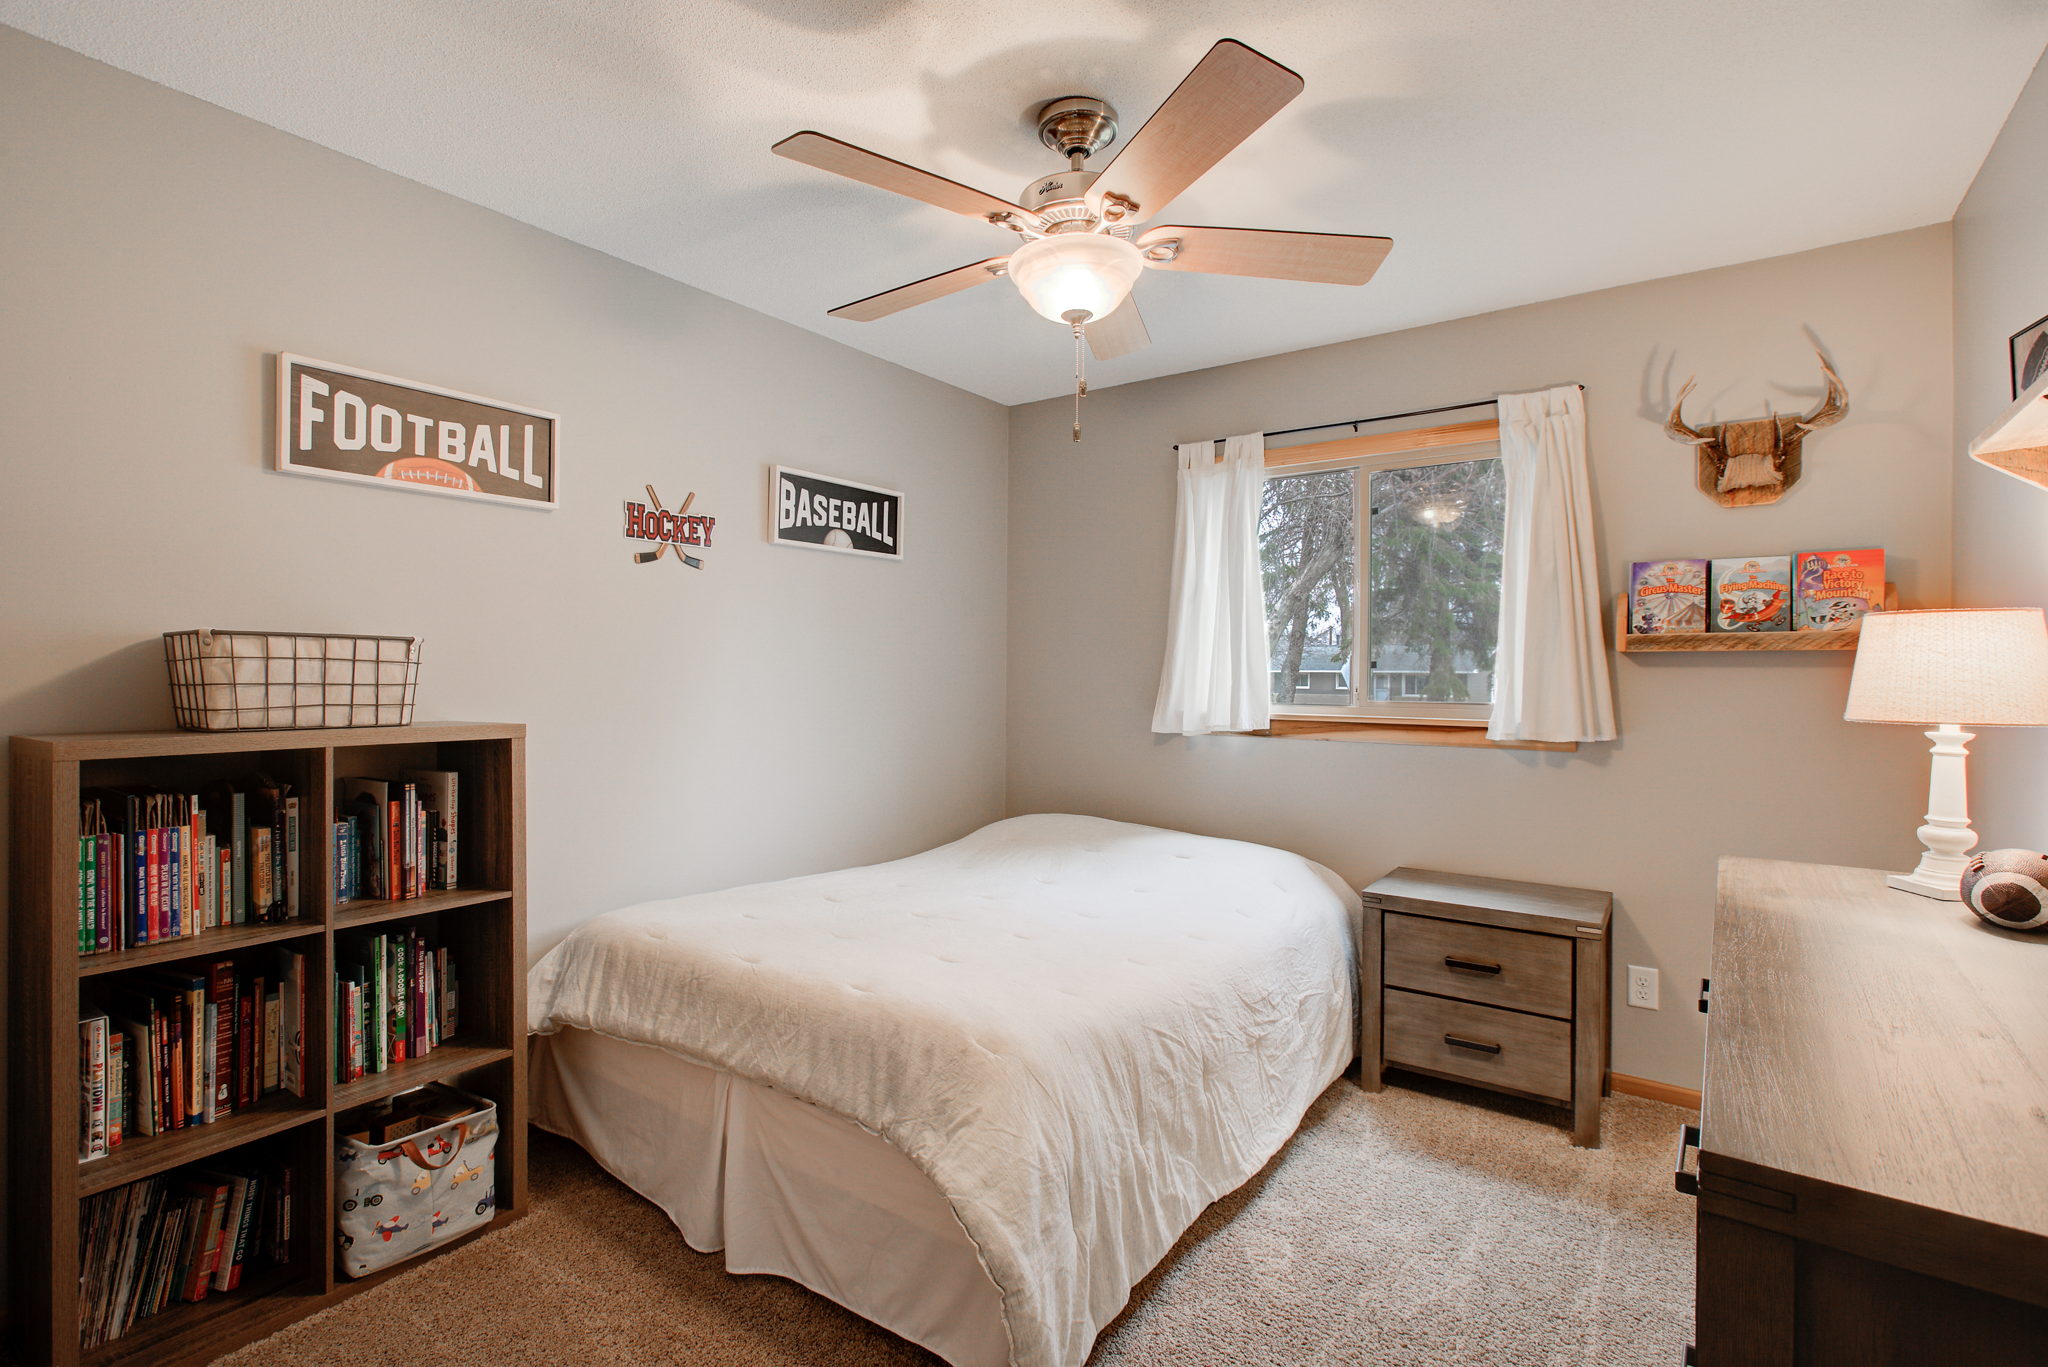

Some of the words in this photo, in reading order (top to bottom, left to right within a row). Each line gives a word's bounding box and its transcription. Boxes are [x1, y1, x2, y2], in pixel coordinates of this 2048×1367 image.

[299, 373, 543, 489] FOOTBALL
[780, 476, 894, 547] BASEBALL
[626, 501, 716, 548] HOCKEY
[1823, 570, 1850, 581] Race
[1851, 568, 1865, 580] to
[1640, 585, 1668, 598] Circus
[1669, 583, 1703, 596] Master
[1720, 581, 1747, 594] Flying
[1748, 579, 1789, 592] Machine
[1823, 579, 1864, 591] Victory
[1815, 588, 1872, 601] Mountain
[93, 1062, 103, 1113] PLAYTOWN
[239, 1228, 247, 1248] THAT
[235, 1249, 243, 1260] GO
